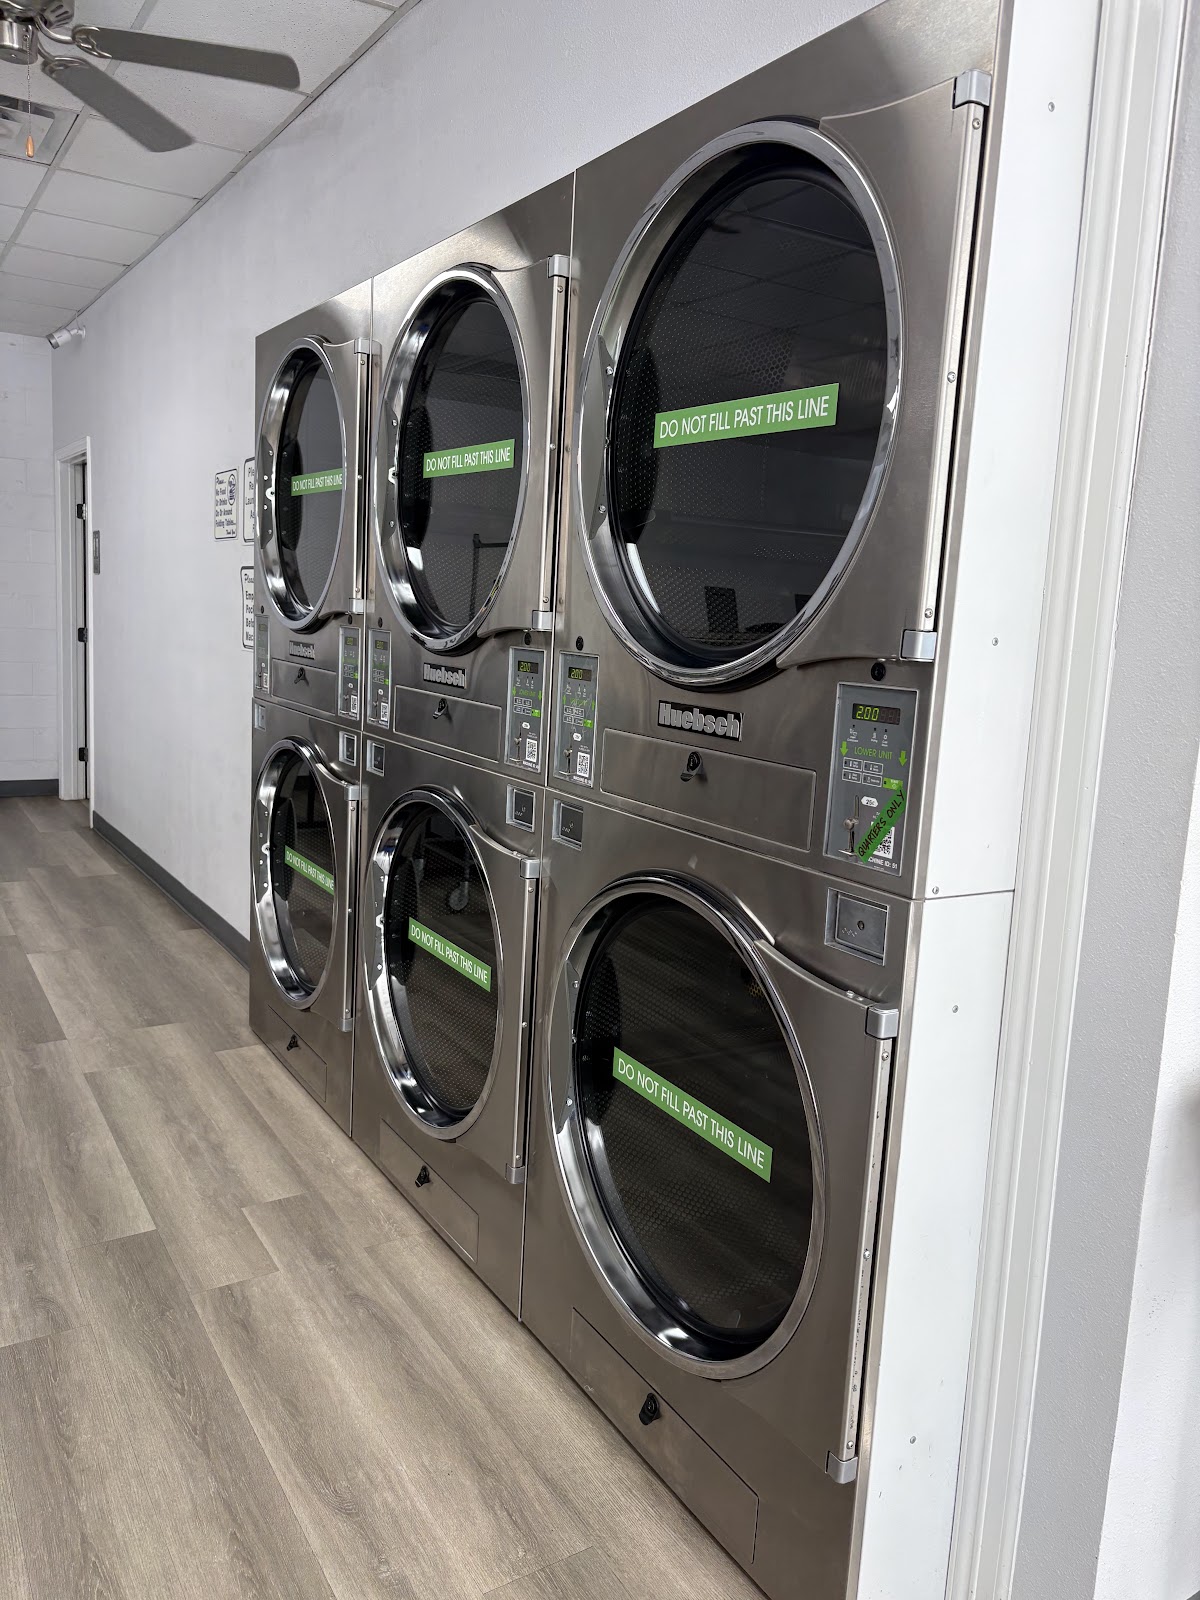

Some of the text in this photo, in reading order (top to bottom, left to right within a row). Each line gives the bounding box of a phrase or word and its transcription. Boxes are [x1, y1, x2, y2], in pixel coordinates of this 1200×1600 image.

[660, 395, 830, 439] DO NOT FILL PAST THIS LINE
[426, 447, 510, 472] DO NOT FILL PAST THIS LINE
[293, 480, 299, 491] DO
[315, 476, 325, 488] PAST
[325, 474, 333, 486] THIS
[333, 473, 342, 485] LINE
[290, 641, 314, 659] Huebsch
[423, 664, 465, 687] Huebsch
[659, 702, 740, 739] Huebsch
[856, 706, 879, 721] 2.00
[854, 746, 893, 760] LOWER UNIT
[858, 817, 887, 857] QUARTERS
[886, 790, 905, 819] ONLY
[286, 850, 292, 863] DO
[293, 855, 301, 868] NOT
[308, 865, 317, 878] PAST
[317, 870, 325, 884] THIS
[325, 876, 334, 890] LINE
[411, 924, 487, 984] DO NOT FILL PAST THIS LINE
[618, 1058, 765, 1169] DO NOT FILL PAST THIS LINE
